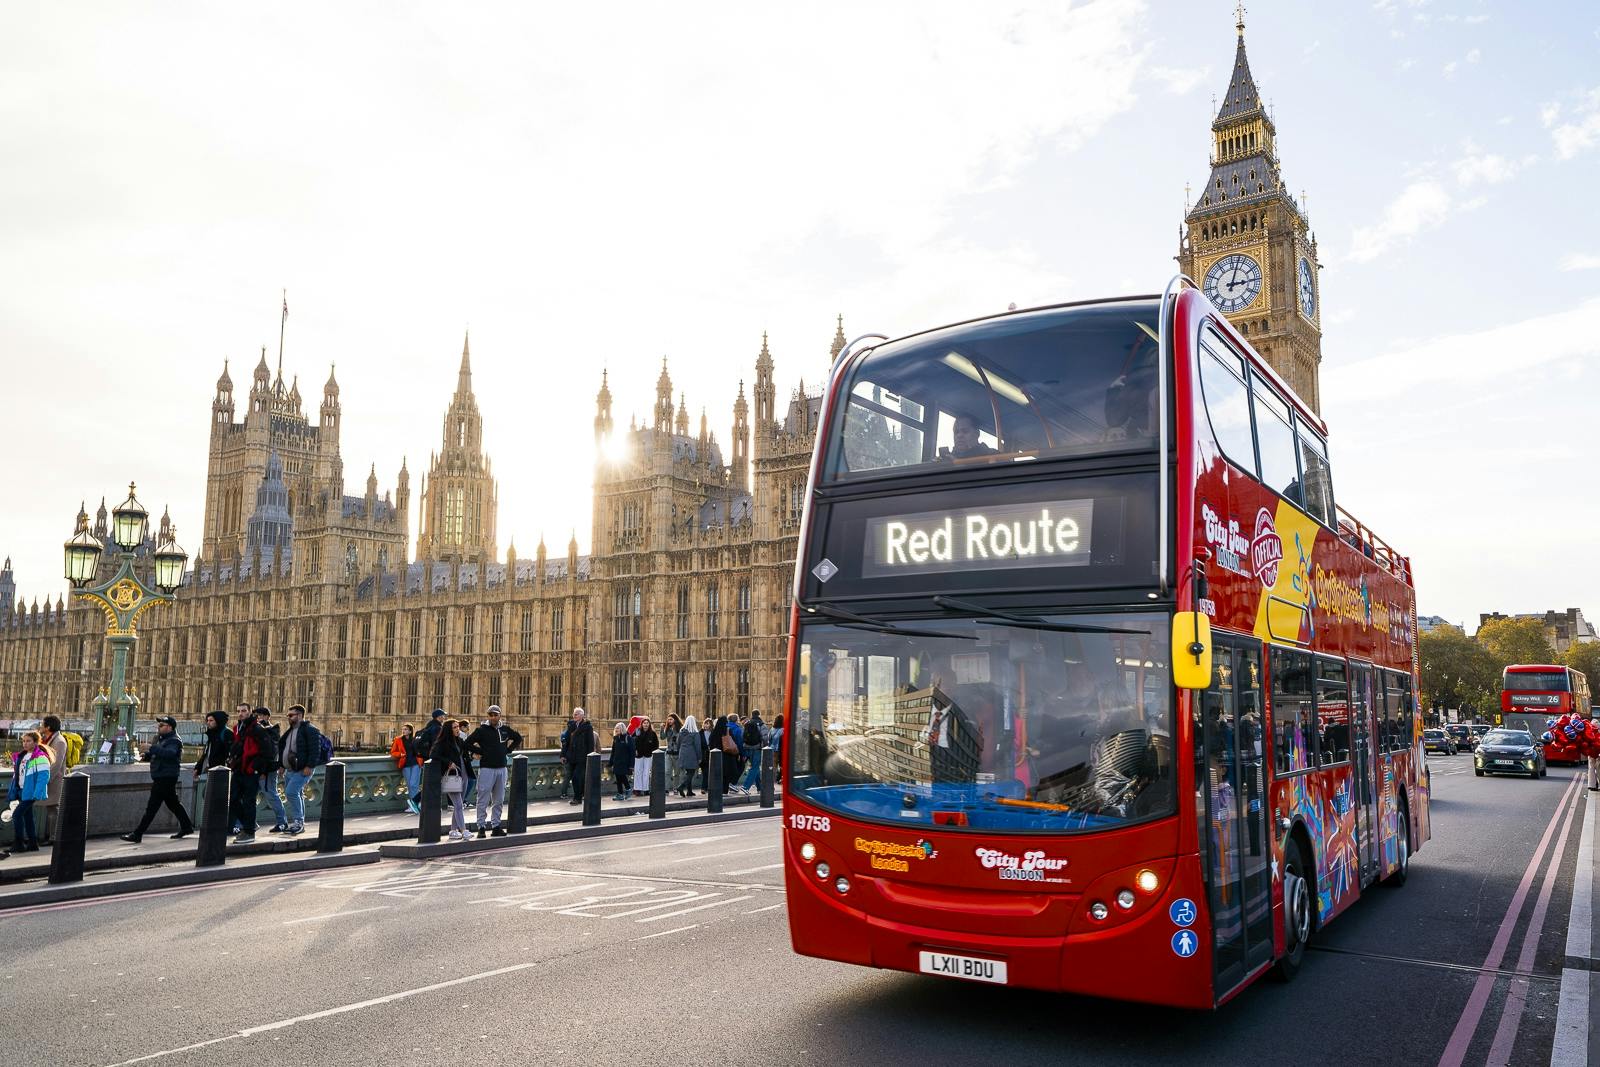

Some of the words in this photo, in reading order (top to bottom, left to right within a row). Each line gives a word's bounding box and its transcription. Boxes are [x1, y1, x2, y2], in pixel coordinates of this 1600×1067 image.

[887, 517, 953, 565] Red
[966, 509, 1080, 560] Route
[1202, 503, 1228, 549] City
[1229, 519, 1250, 556] Tour
[1254, 538, 1282, 569] OFFICIAL
[1199, 598, 1216, 617] 19758
[1547, 695, 1559, 703] 26
[789, 813, 831, 832] 19758
[871, 854, 910, 873] London
[975, 847, 1020, 870] City
[1022, 850, 1068, 871] Tour
[999, 868, 1044, 881] LONDON
[466, 882, 756, 923] A3211
[931, 954, 960, 974] LX11
[963, 959, 994, 979] BDU
